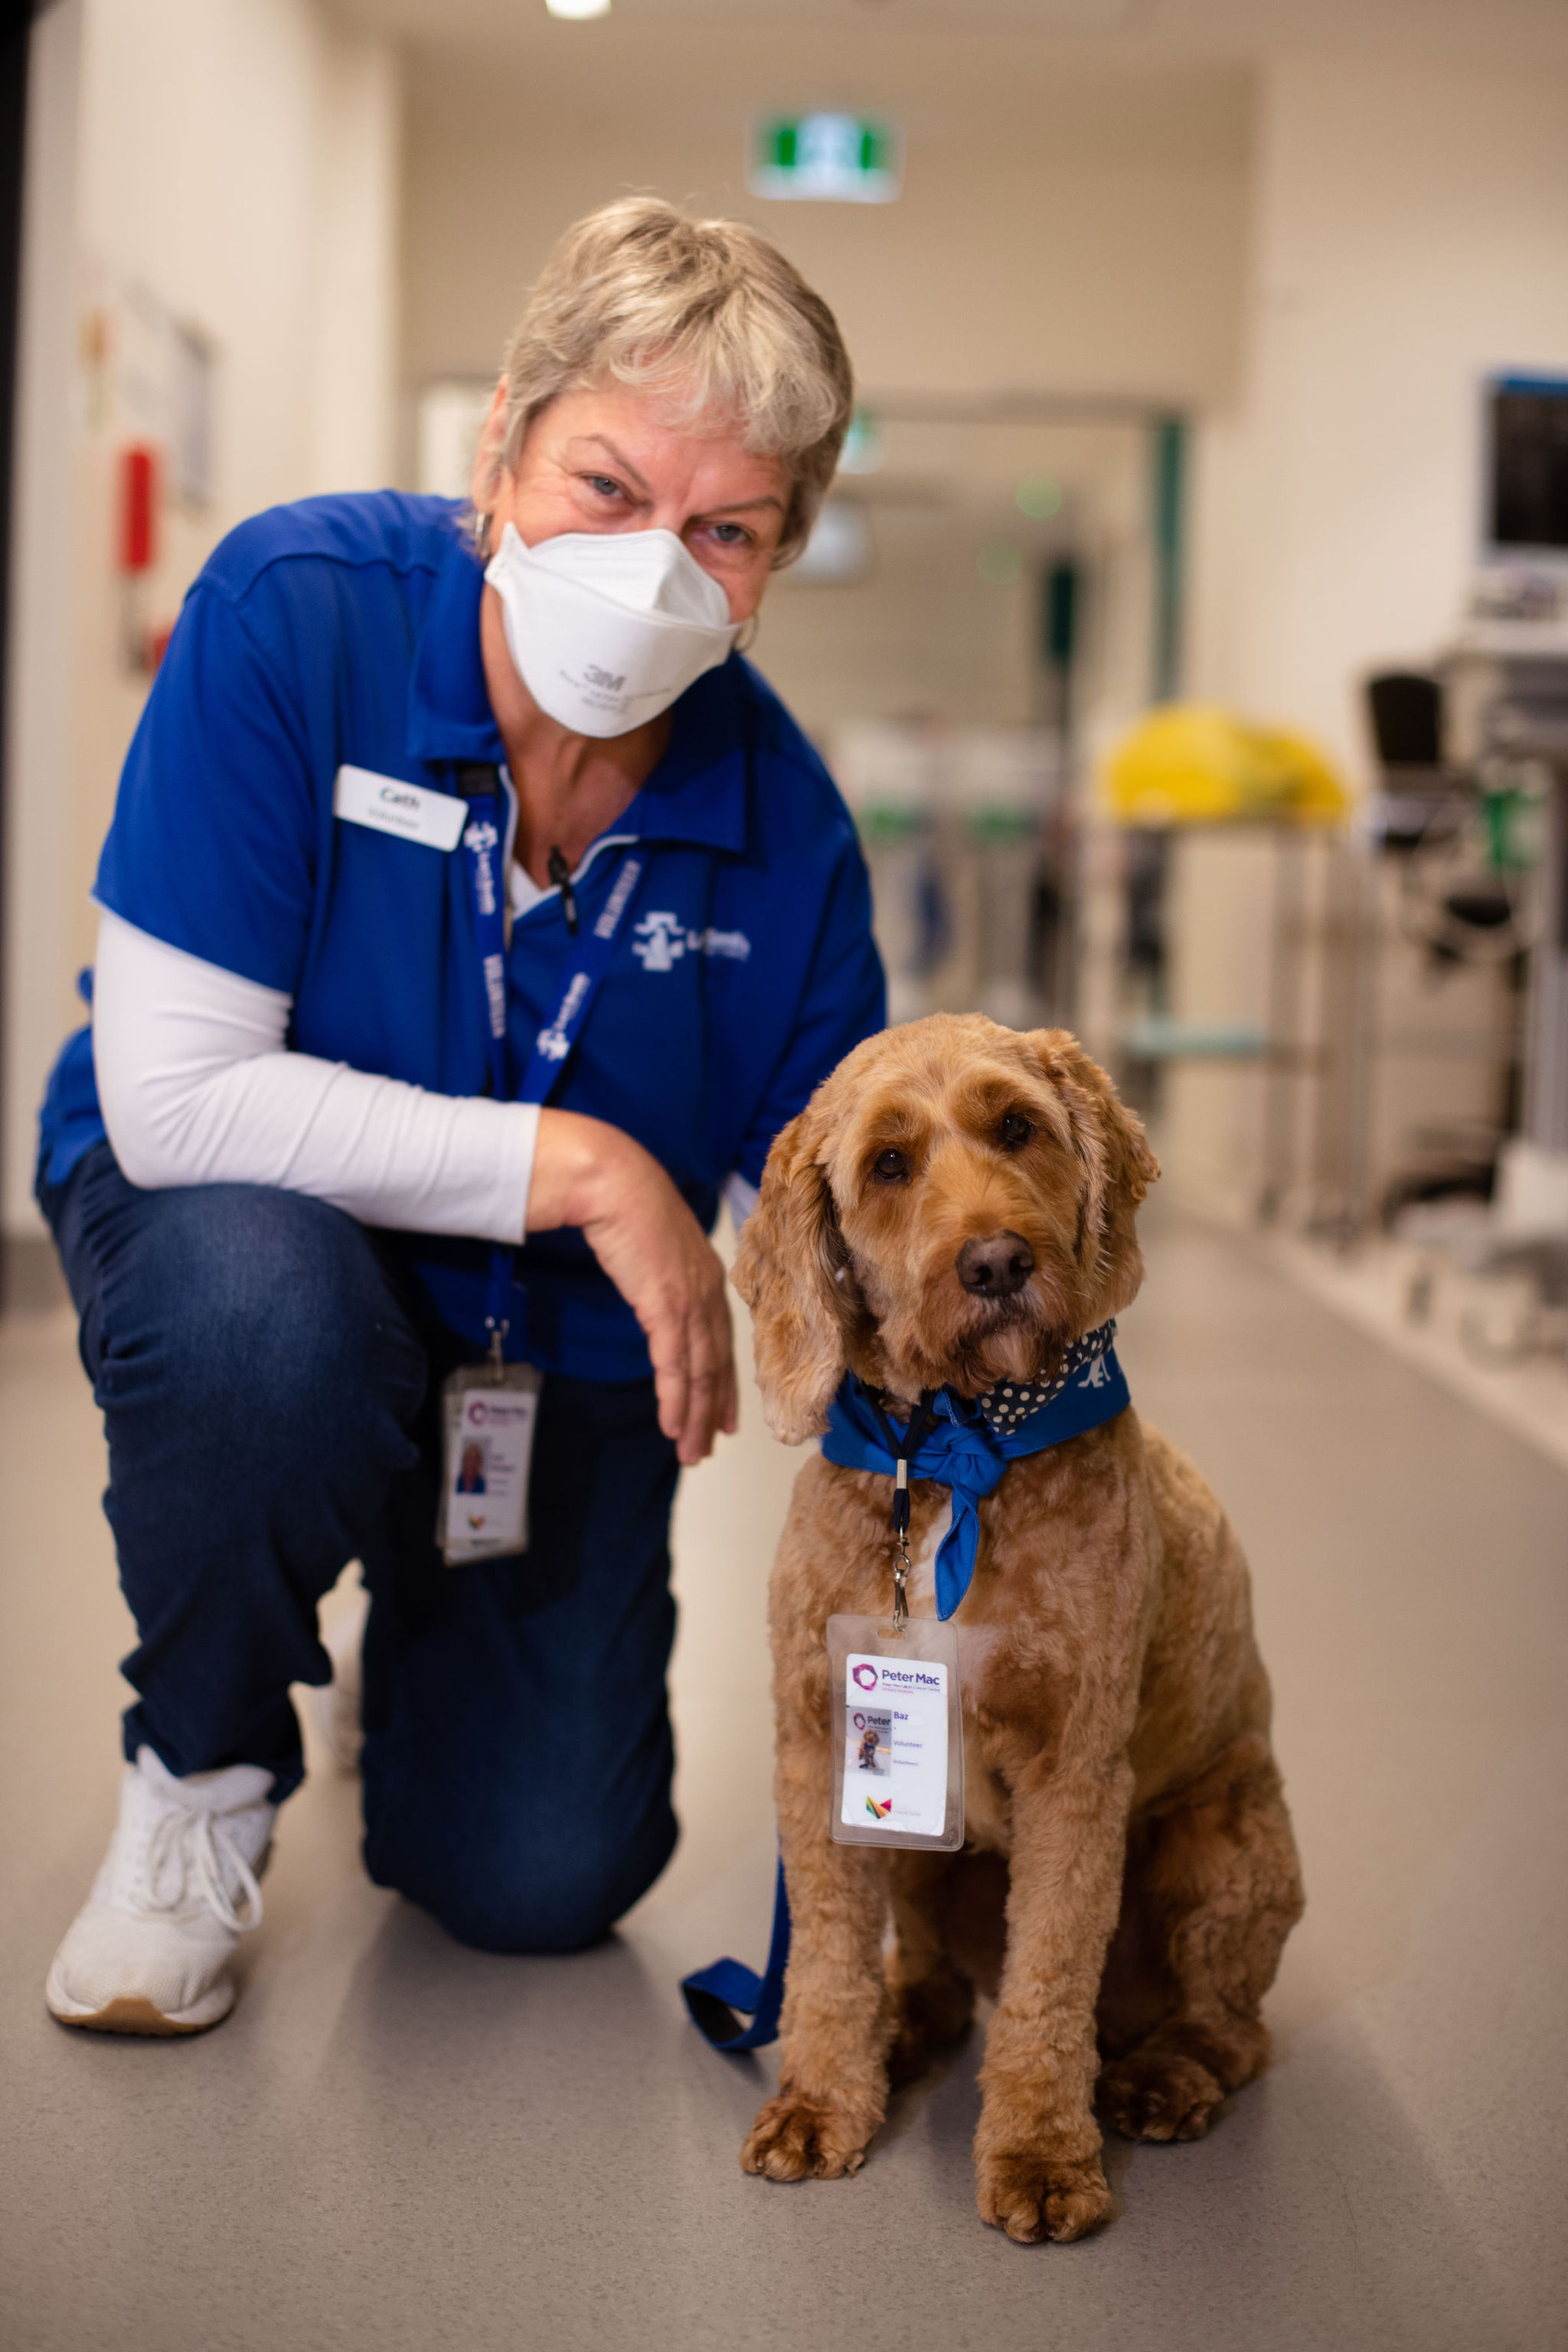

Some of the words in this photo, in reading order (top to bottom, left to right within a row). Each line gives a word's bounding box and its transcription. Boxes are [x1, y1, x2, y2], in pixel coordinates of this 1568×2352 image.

[583, 663, 626, 691] 3M
[380, 787, 420, 810] Cath
[881, 1669, 913, 1683] Peter
[916, 1673, 940, 1685] Mac
[867, 1716, 890, 1726] Peter
[893, 1711, 909, 1720] Baz
[893, 1740, 923, 1748] Volunteer
